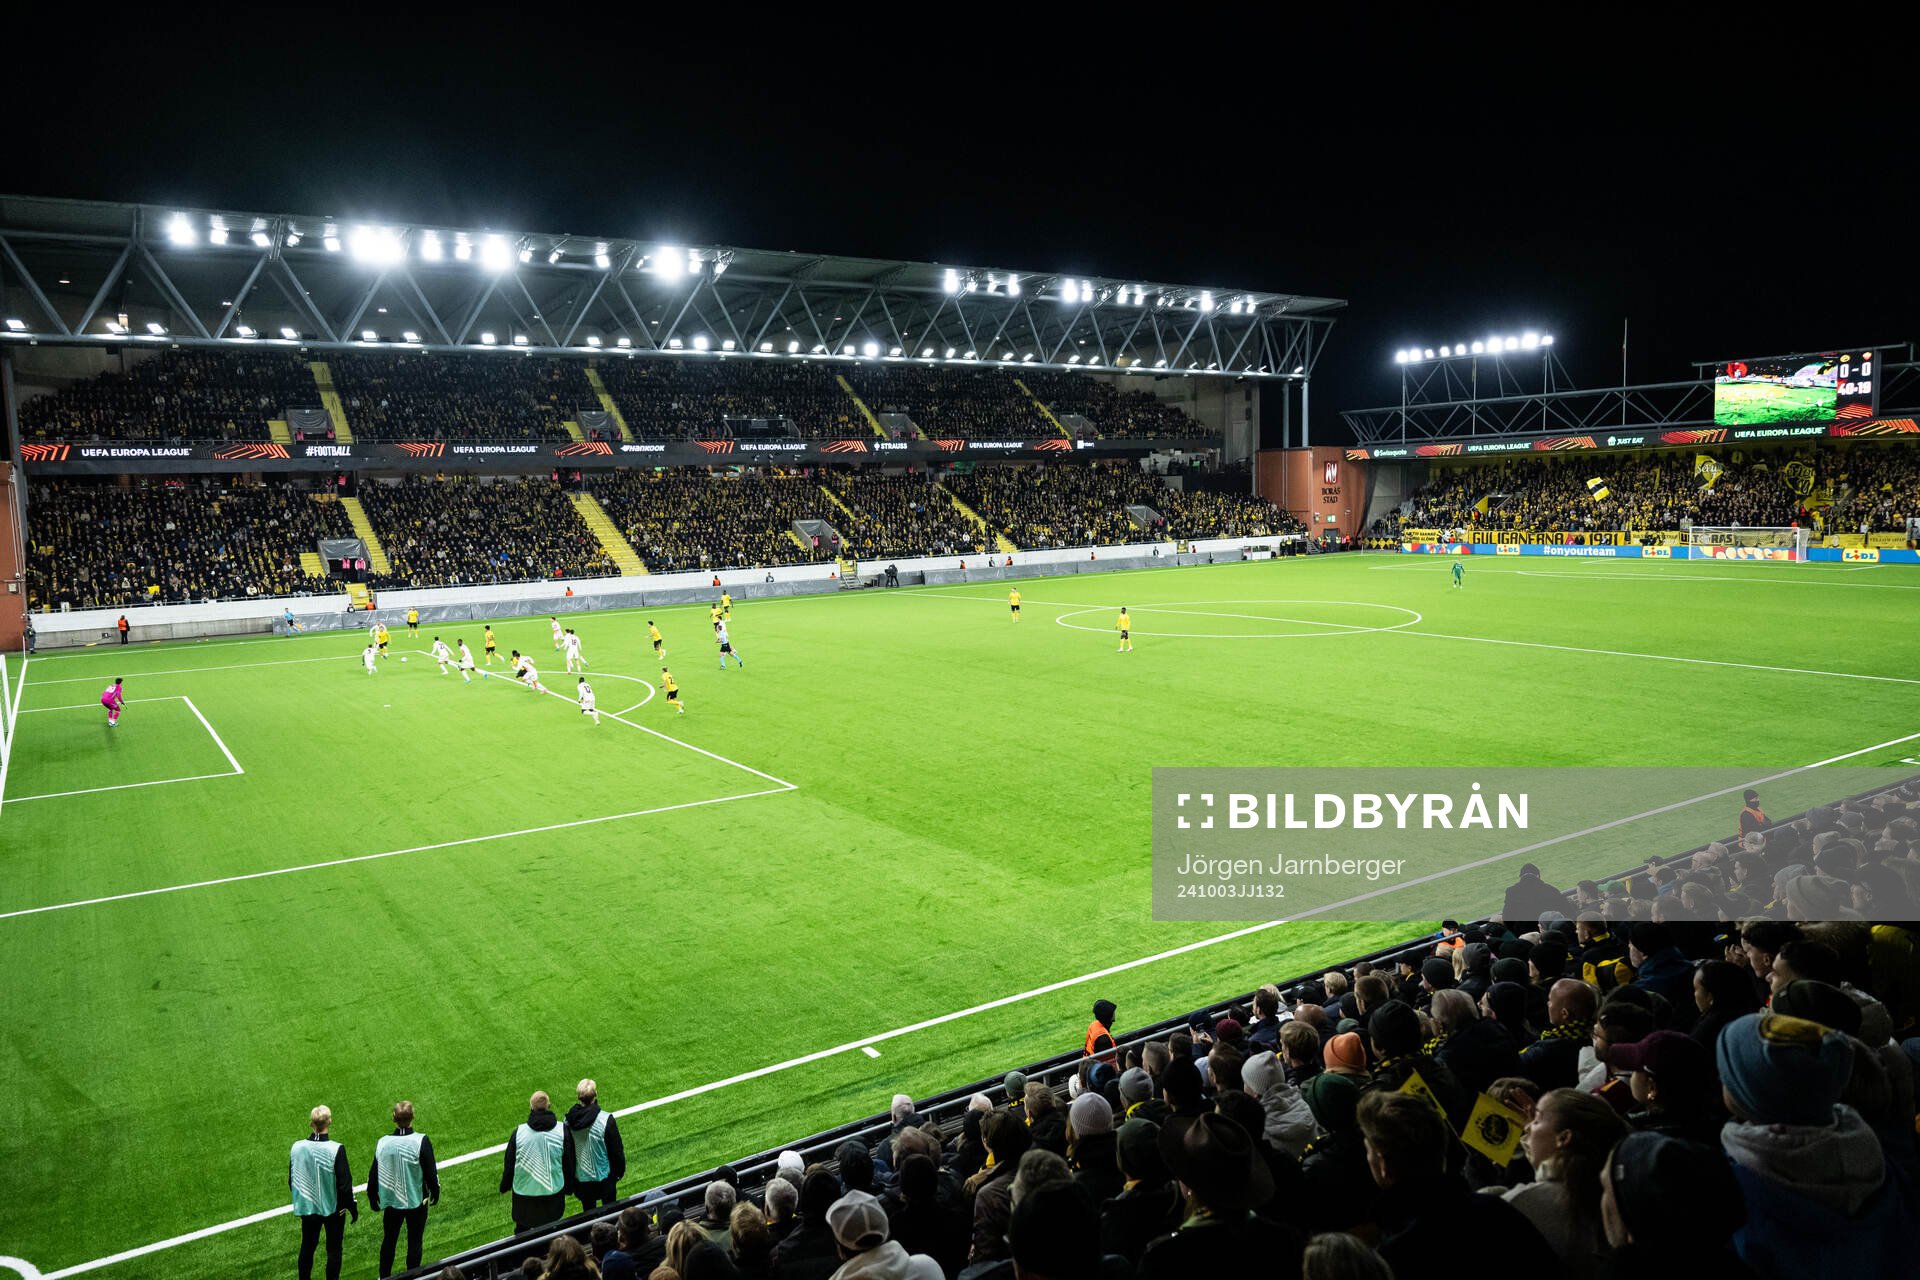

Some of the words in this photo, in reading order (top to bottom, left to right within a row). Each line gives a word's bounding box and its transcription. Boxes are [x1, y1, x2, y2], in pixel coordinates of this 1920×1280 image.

[1840, 363, 1849, 378] 0
[1861, 361, 1871, 376] 0
[1756, 429, 1789, 437] EUROPA
[1790, 427, 1824, 435] LEAGUE
[110, 448, 150, 456] EUROPA
[151, 448, 190, 456] LEAGUE
[305, 445, 352, 457] #FOOTBALL
[507, 445, 536, 453] LEAGUE
[1544, 545, 1616, 556] #onyourteam
